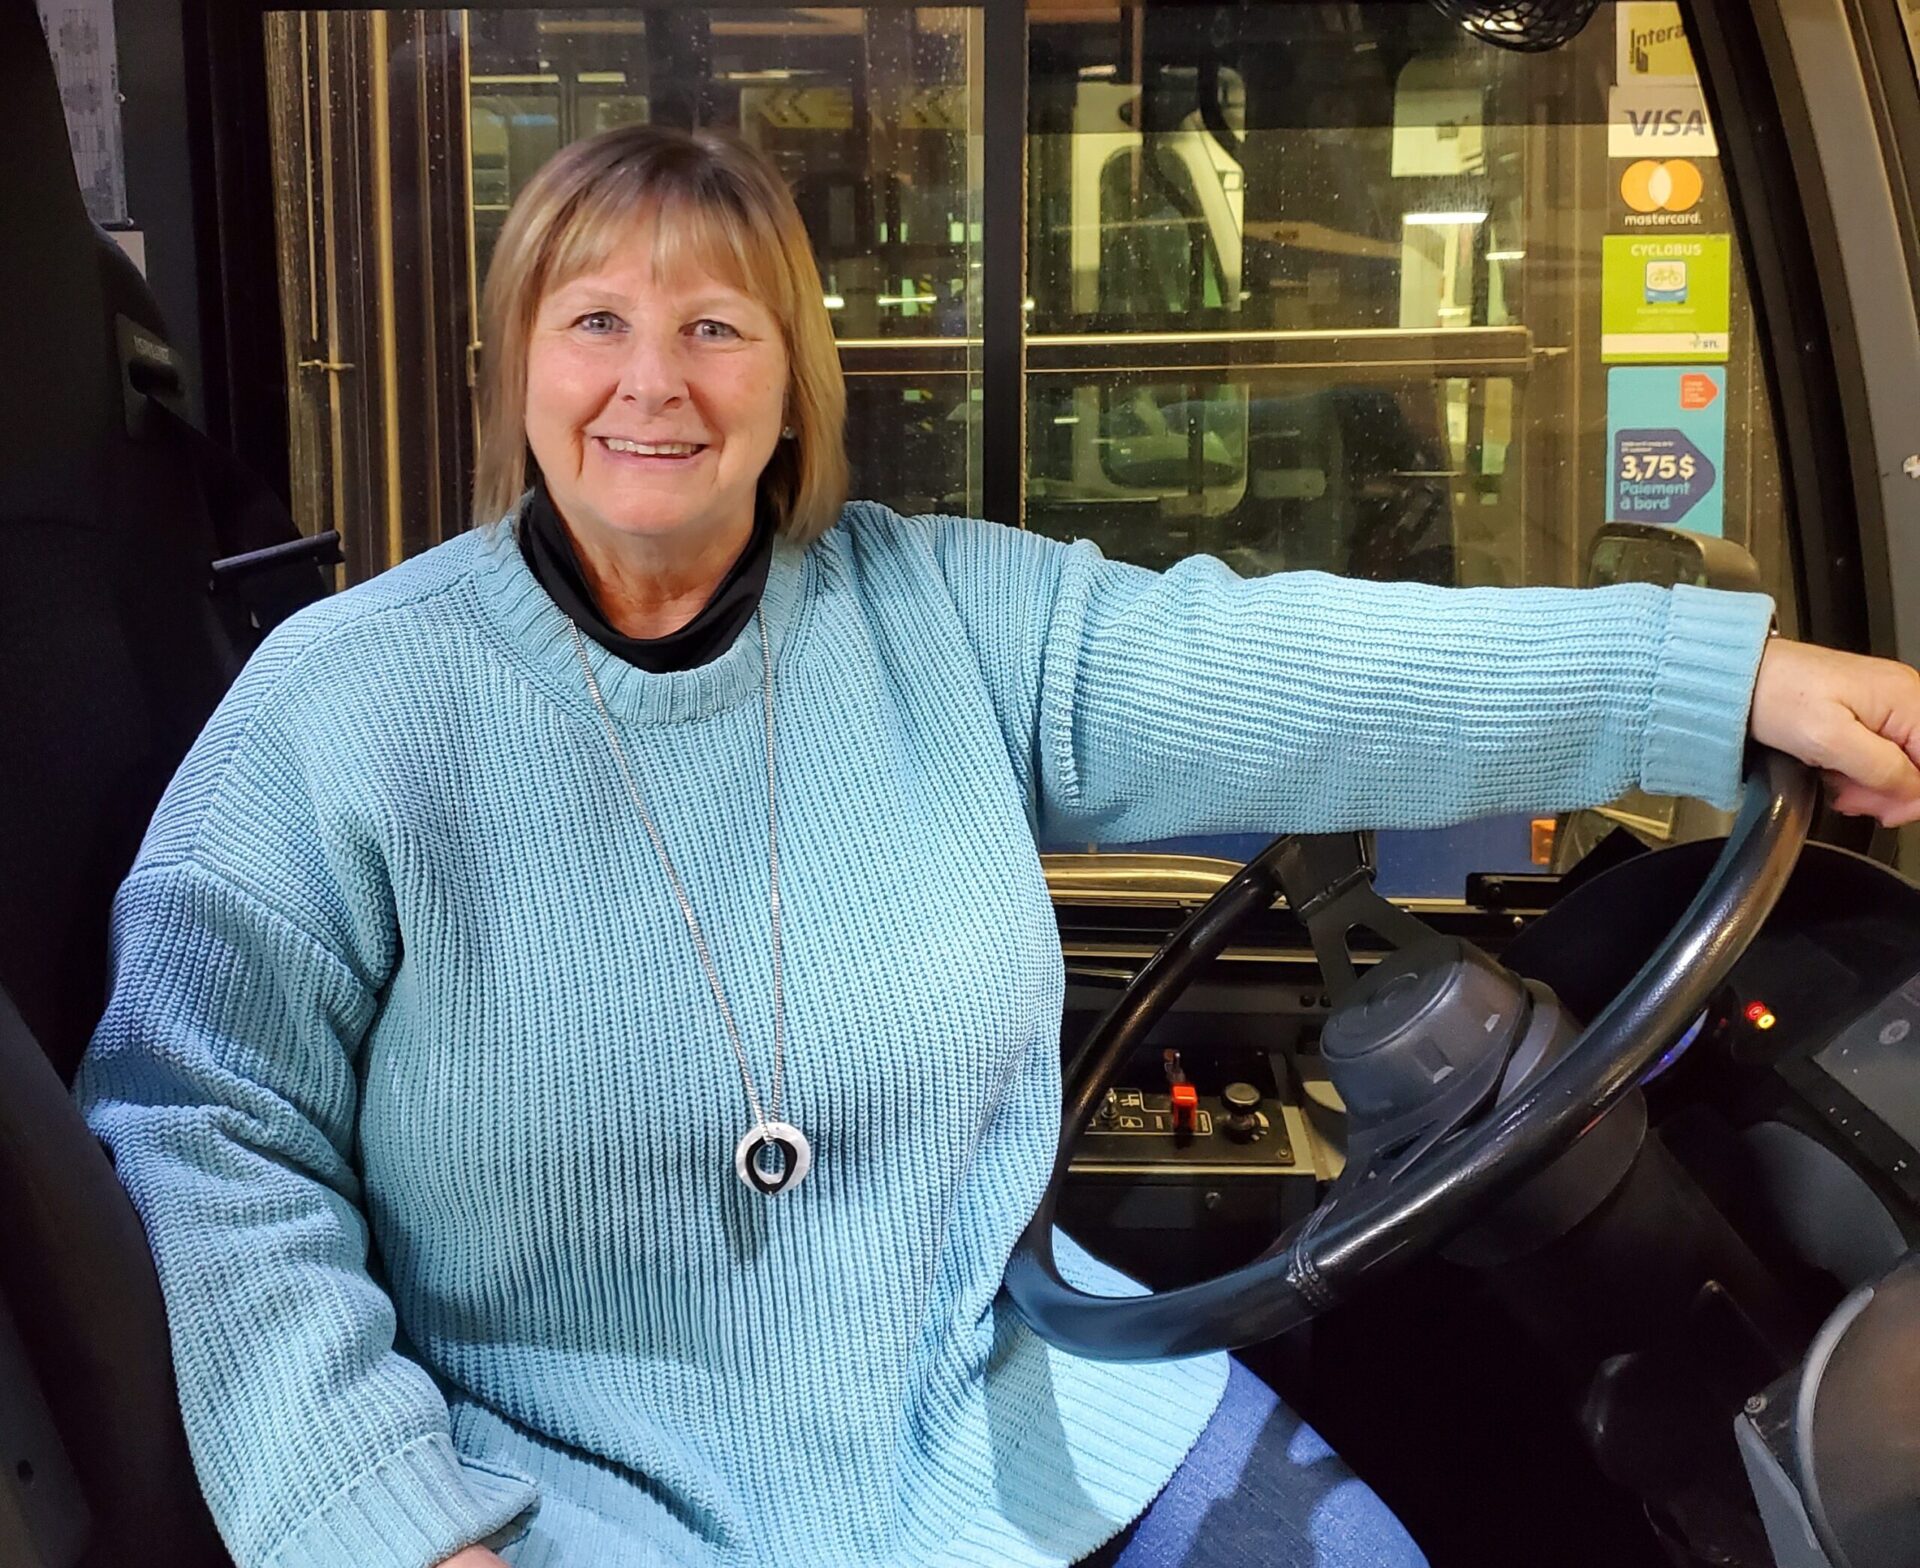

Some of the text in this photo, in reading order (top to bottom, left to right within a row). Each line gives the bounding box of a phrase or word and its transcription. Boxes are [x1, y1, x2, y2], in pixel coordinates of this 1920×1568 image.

[1624, 110, 1707, 136] VISA
[1631, 243, 1702, 256] CYCLOBUS
[1620, 481, 1690, 495] Paiement
[1620, 497, 1671, 510] à bord
